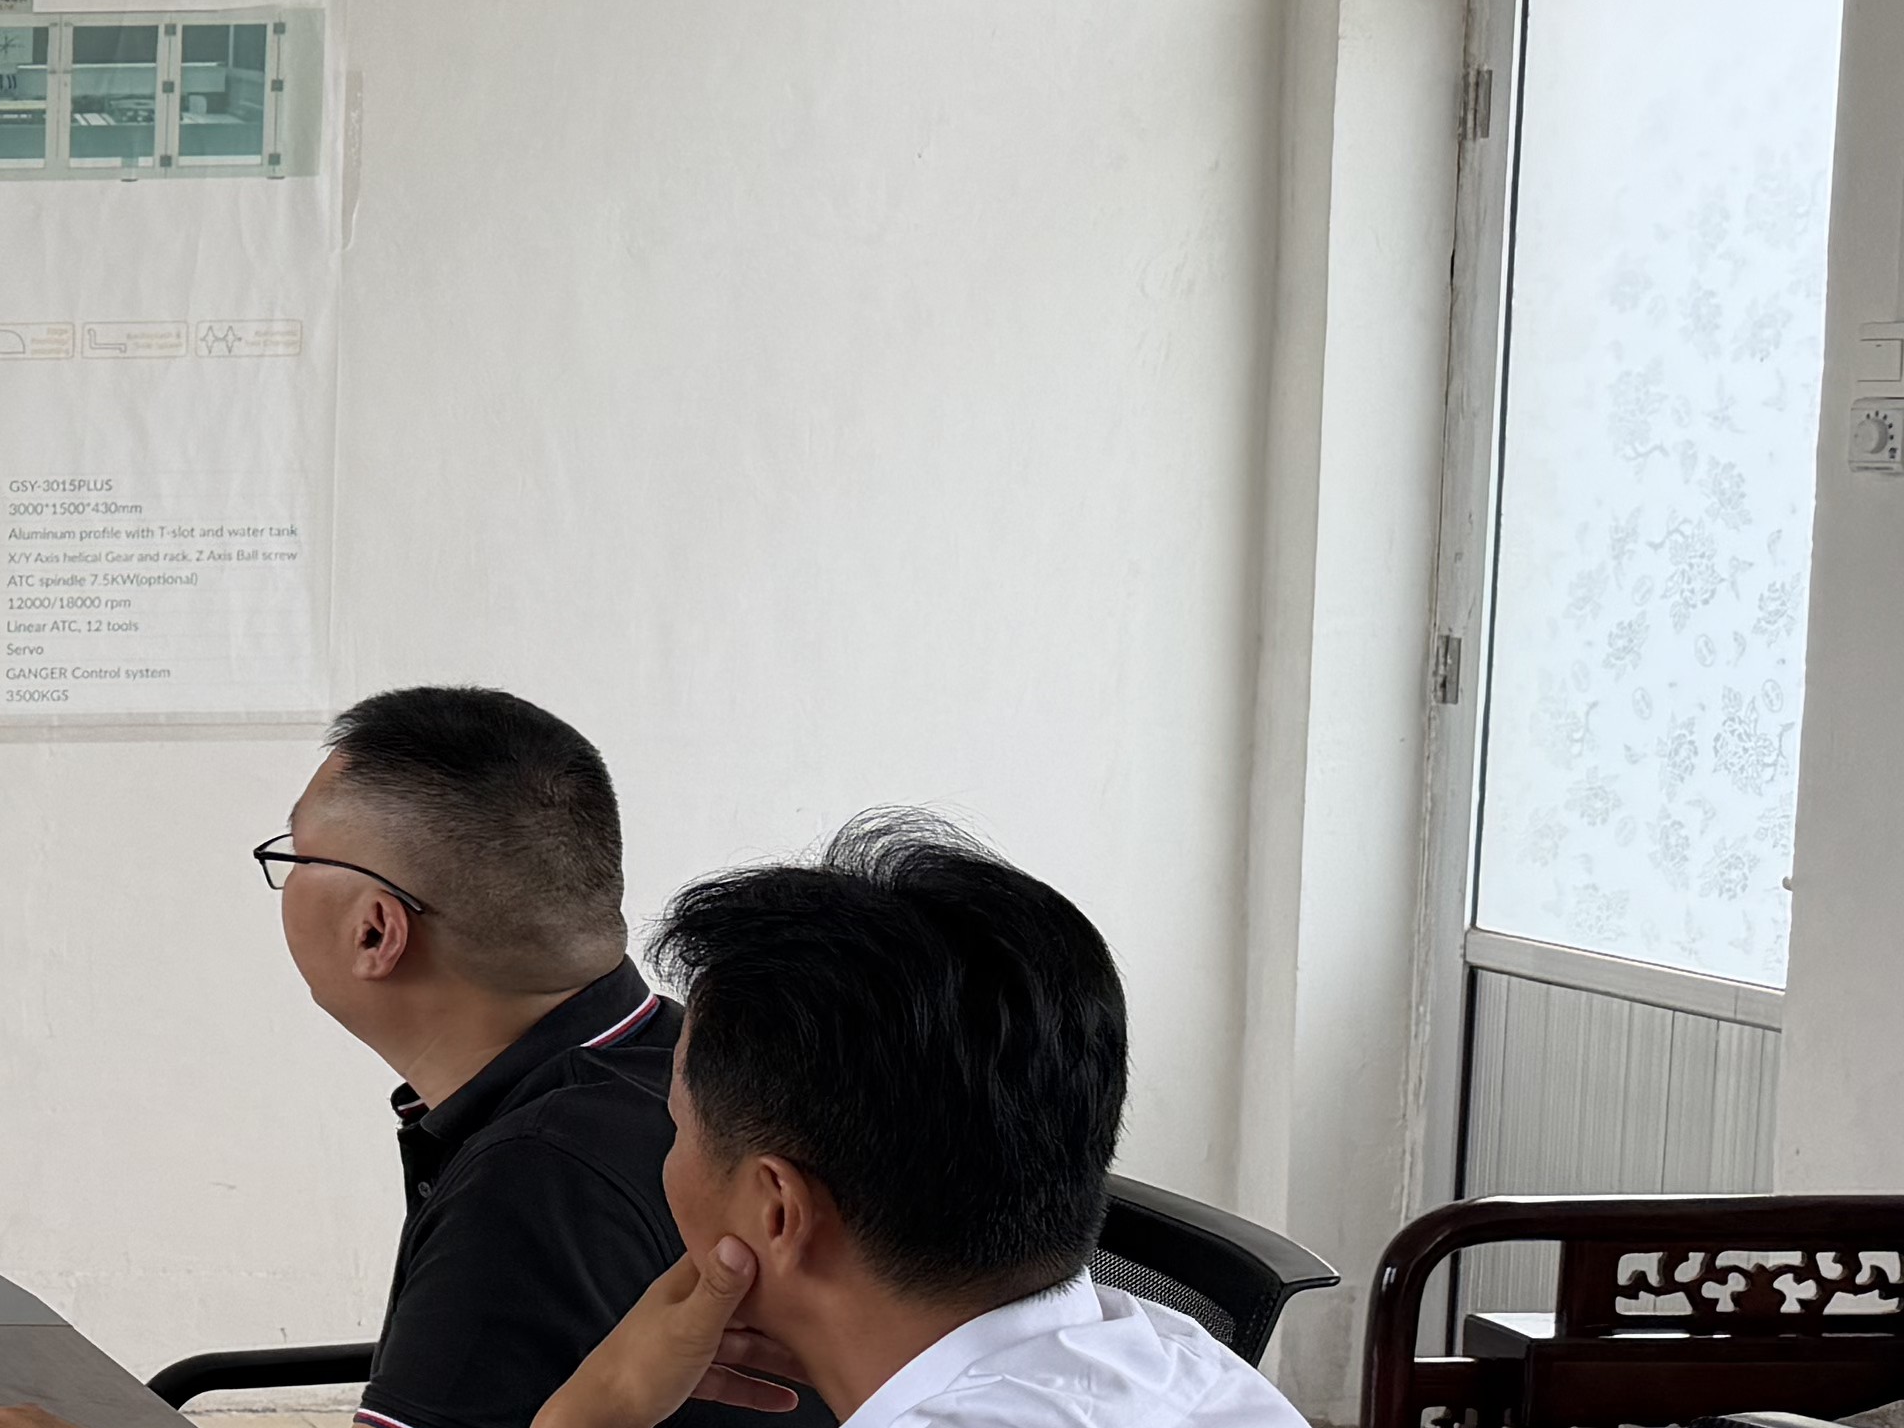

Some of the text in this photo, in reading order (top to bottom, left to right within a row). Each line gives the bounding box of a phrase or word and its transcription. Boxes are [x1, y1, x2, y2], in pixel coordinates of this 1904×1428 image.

[8, 478, 114, 493] GSY-3015PLUS
[8, 527, 76, 541] Aluminum
[79, 526, 122, 542] profile
[124, 526, 155, 540] with
[199, 525, 224, 538] and
[227, 525, 266, 538] water
[268, 524, 298, 537] tank
[8, 596, 131, 611] 12000/18000 rpm
[7, 619, 46, 633] Linear
[86, 620, 103, 632] 12
[107, 619, 140, 633] tools
[6, 642, 44, 656] Servo
[5, 666, 171, 681] GANGER Control system
